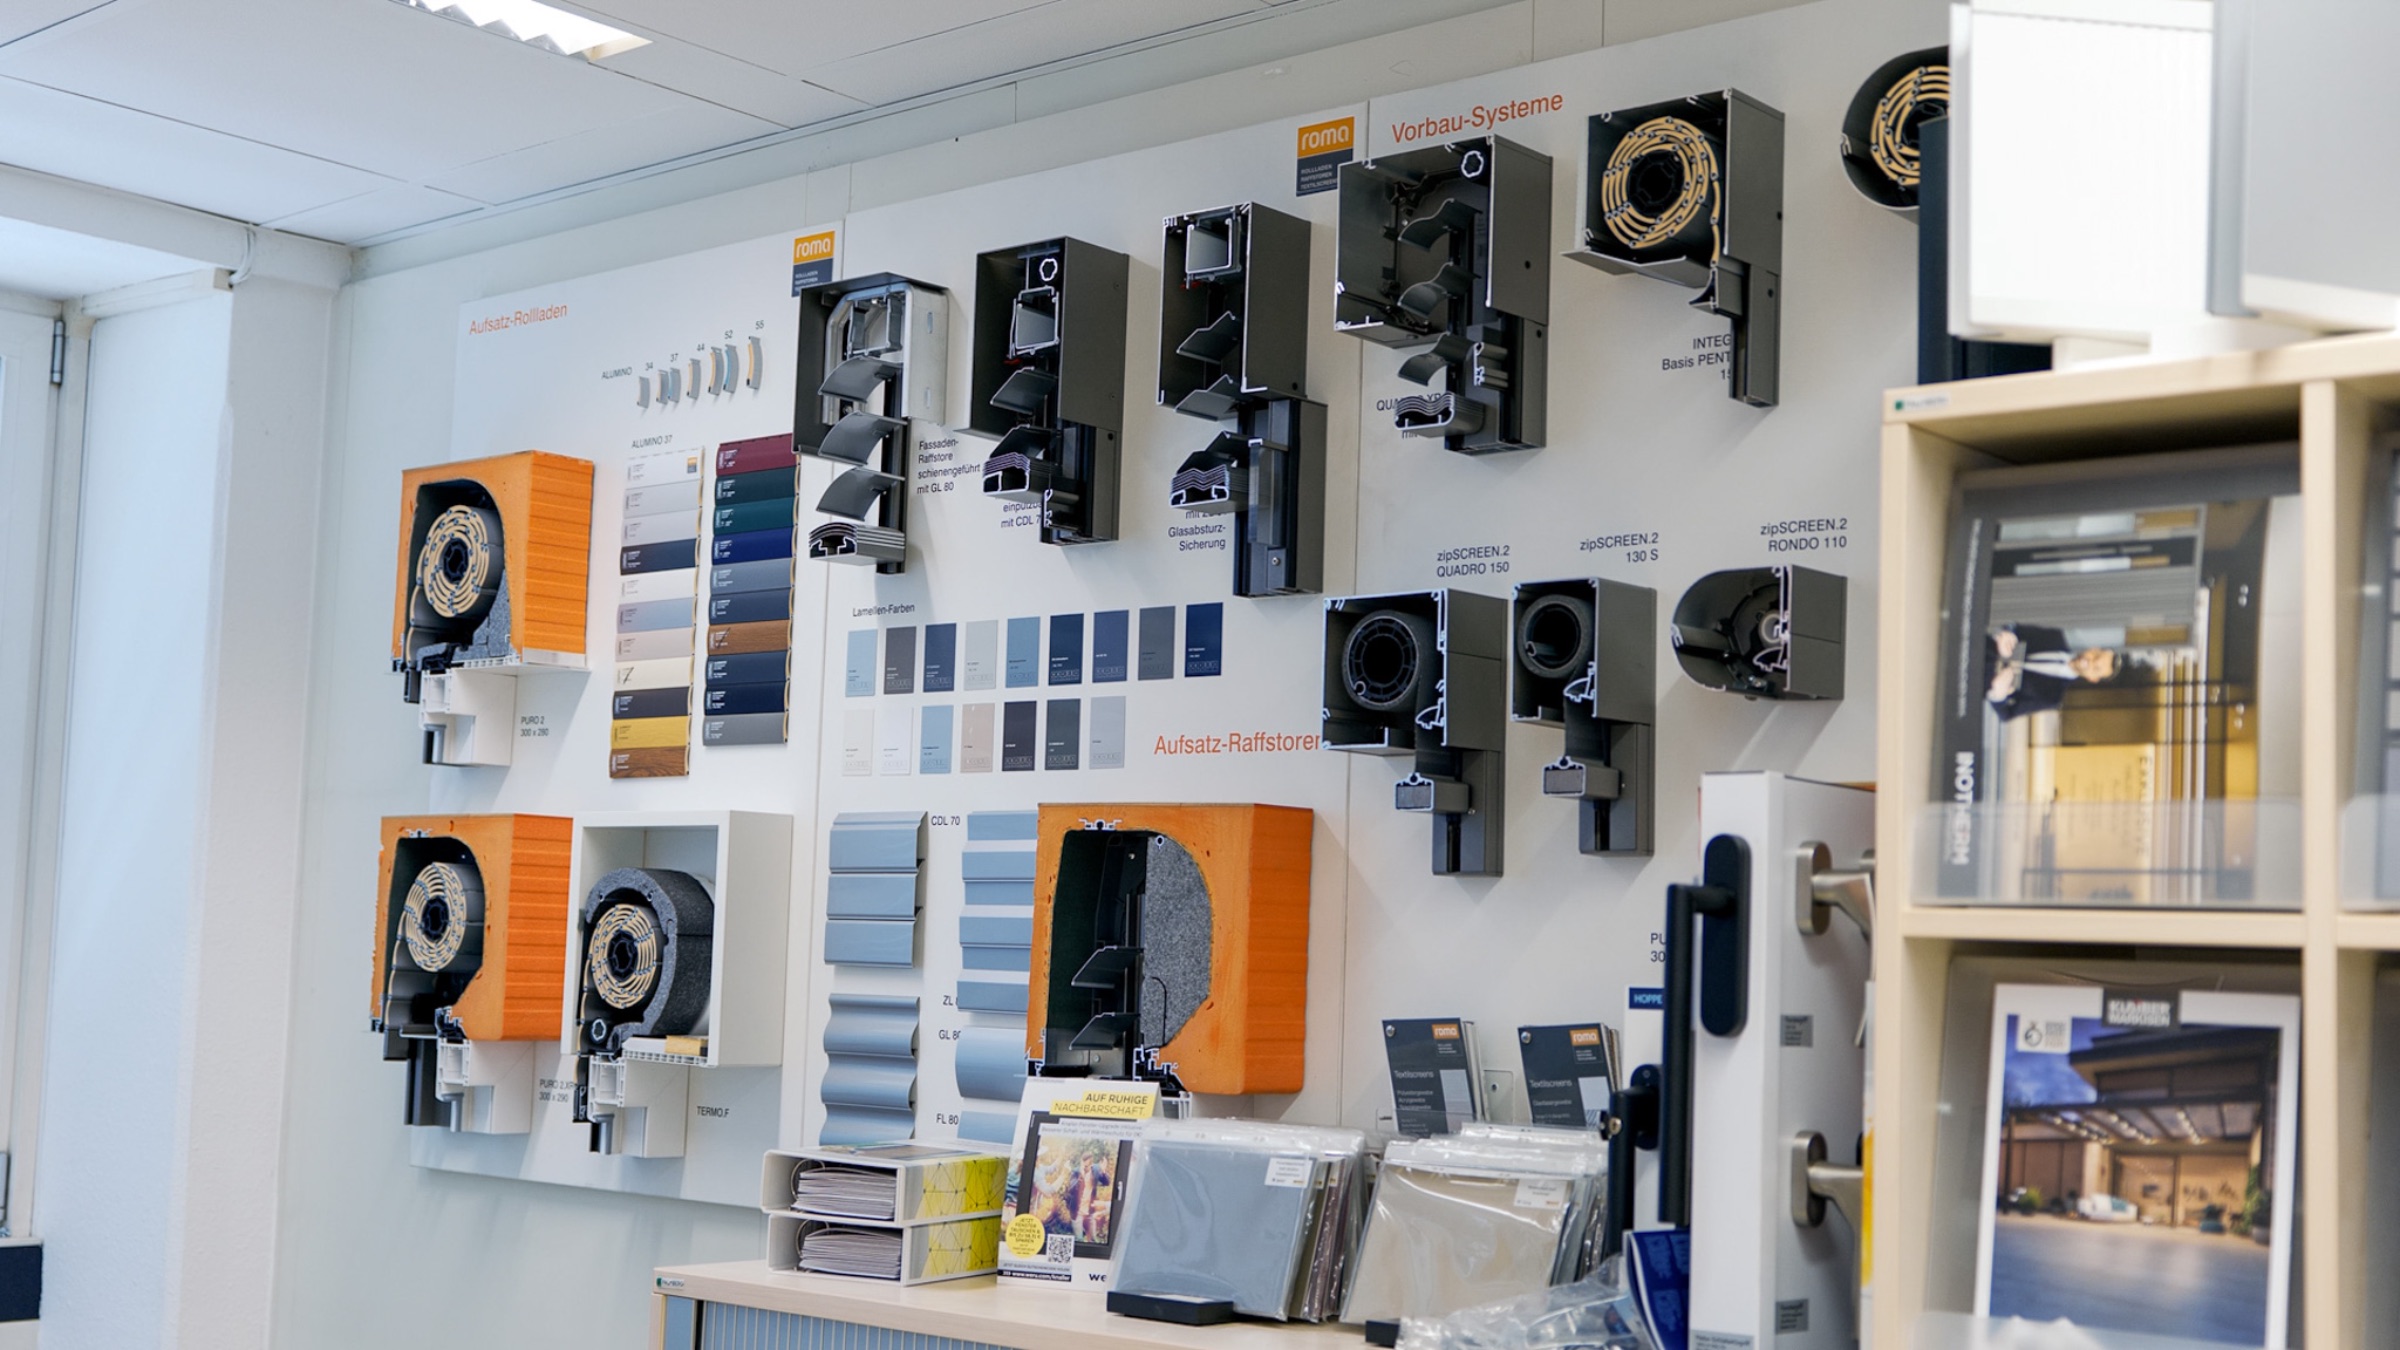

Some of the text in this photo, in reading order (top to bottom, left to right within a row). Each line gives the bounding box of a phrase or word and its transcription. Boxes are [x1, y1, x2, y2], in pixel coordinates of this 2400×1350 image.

[1392, 94, 1563, 143] Vorbau-Systeme
[1302, 125, 1349, 151] roma
[796, 238, 831, 258] roma
[469, 304, 567, 335] Aufsatz-Rollladen
[1693, 333, 1732, 349] INTEG
[602, 367, 632, 379] ALUMINO
[645, 362, 653, 371] 34
[670, 353, 678, 362] 37
[724, 330, 733, 340] 52
[755, 320, 764, 330] 55
[1662, 356, 1694, 370] Basis
[632, 435, 672, 449] ALUMINO 37
[919, 438, 958, 450] Fassaden-
[918, 453, 953, 464] Raffstore
[918, 463, 980, 479] schienengeführt
[917, 481, 954, 494] mit GL 80
[1015, 515, 1034, 526] CDL
[1168, 524, 1226, 538] Glasabsturz-
[1760, 518, 1847, 538] zipSCREEN.2
[1179, 539, 1226, 551] Sicherung
[1580, 532, 1659, 552] zipSCREEN.2
[1768, 536, 1847, 552] RONDO 110
[1437, 545, 1510, 563] zipSCREEN.2
[1626, 548, 1659, 563] 130 S
[1437, 561, 1509, 577] QUADRO 150
[852, 604, 915, 617] Lamellen-Farben
[1951, 751, 1975, 866] INOTHERM
[931, 815, 961, 826] CDL 70
[1634, 993, 1663, 1005] HOPPE
[939, 1029, 951, 1040] GL
[1434, 1027, 1457, 1036] roma
[1573, 1033, 1597, 1042] roma
[1529, 1080, 1573, 1088] Textilscreens
[1086, 1093, 1148, 1105] AUF RUHIGE
[697, 1106, 730, 1118] TERMO.F
[1054, 1102, 1146, 1116] NACHBARSCHAFT.
[936, 1112, 959, 1125] FL 80
